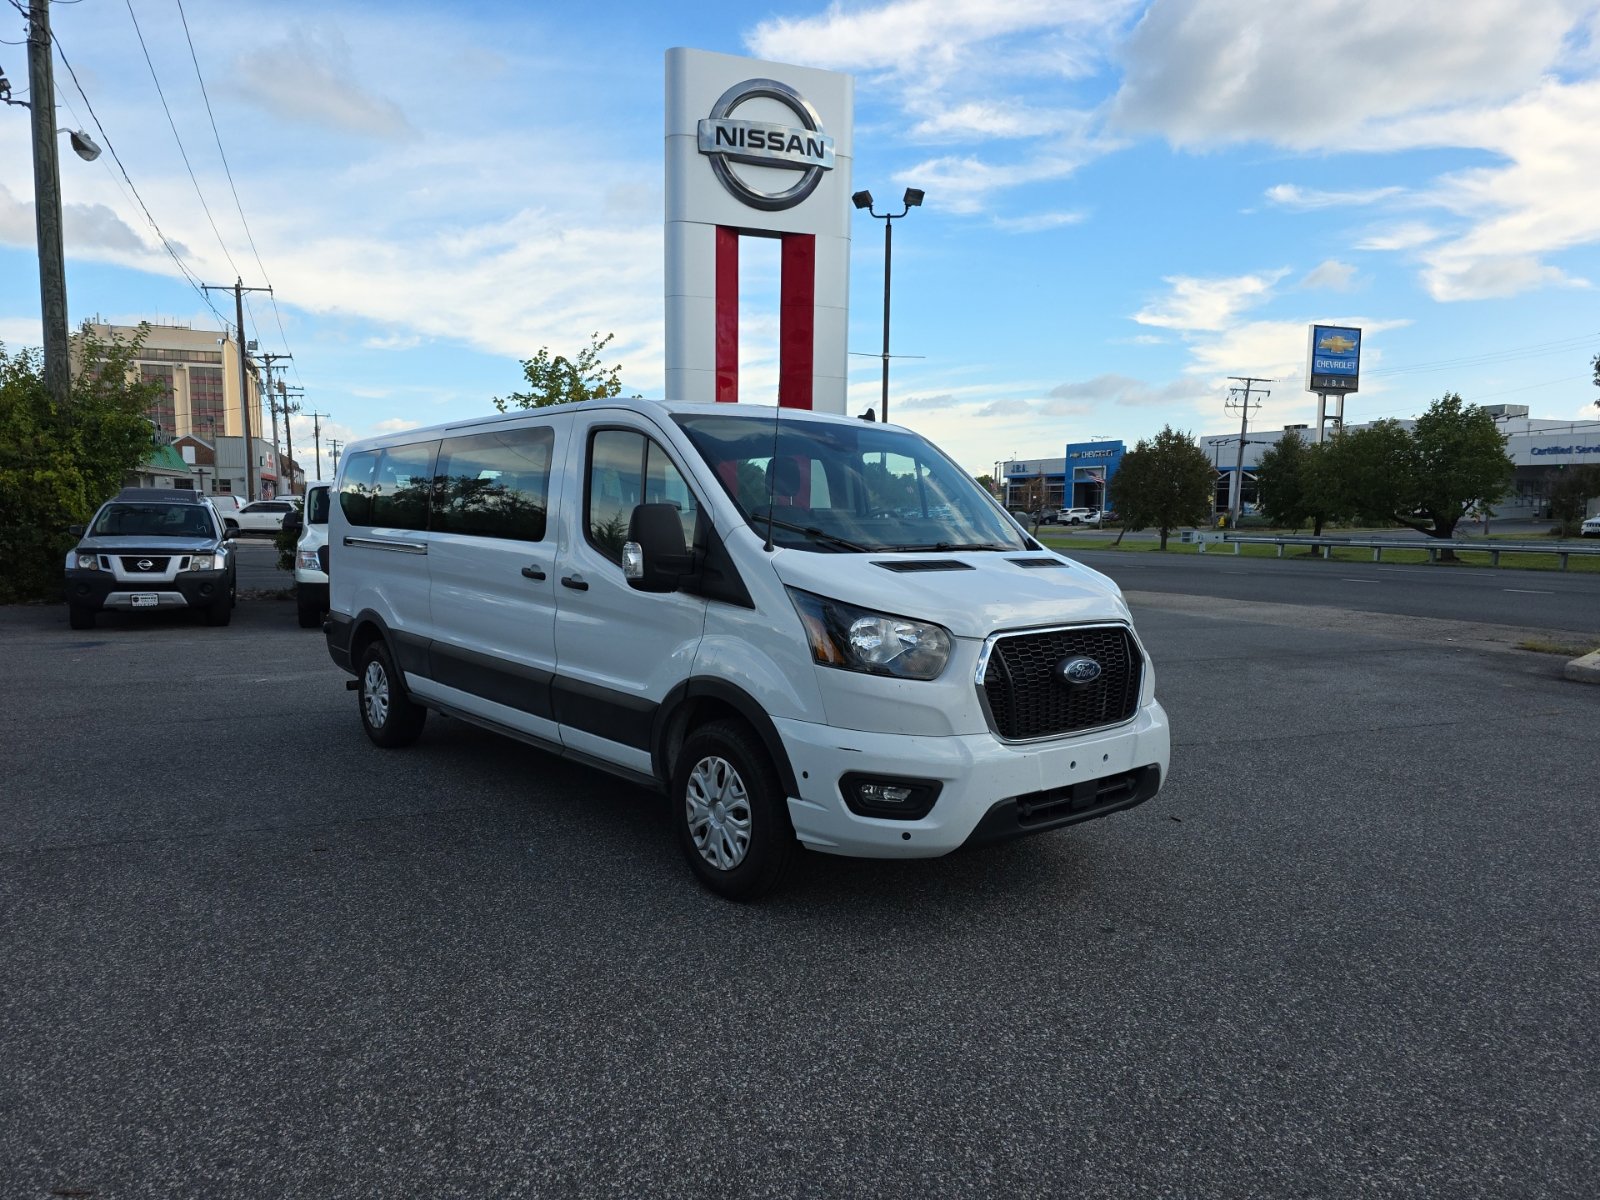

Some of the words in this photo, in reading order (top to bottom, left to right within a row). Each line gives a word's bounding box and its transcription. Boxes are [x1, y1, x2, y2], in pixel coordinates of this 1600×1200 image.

[716, 126, 824, 159] NISSAN
[1316, 359, 1355, 369] CHEVROLET
[1531, 444, 1573, 456] Certified
[1075, 663, 1095, 678] Ford
